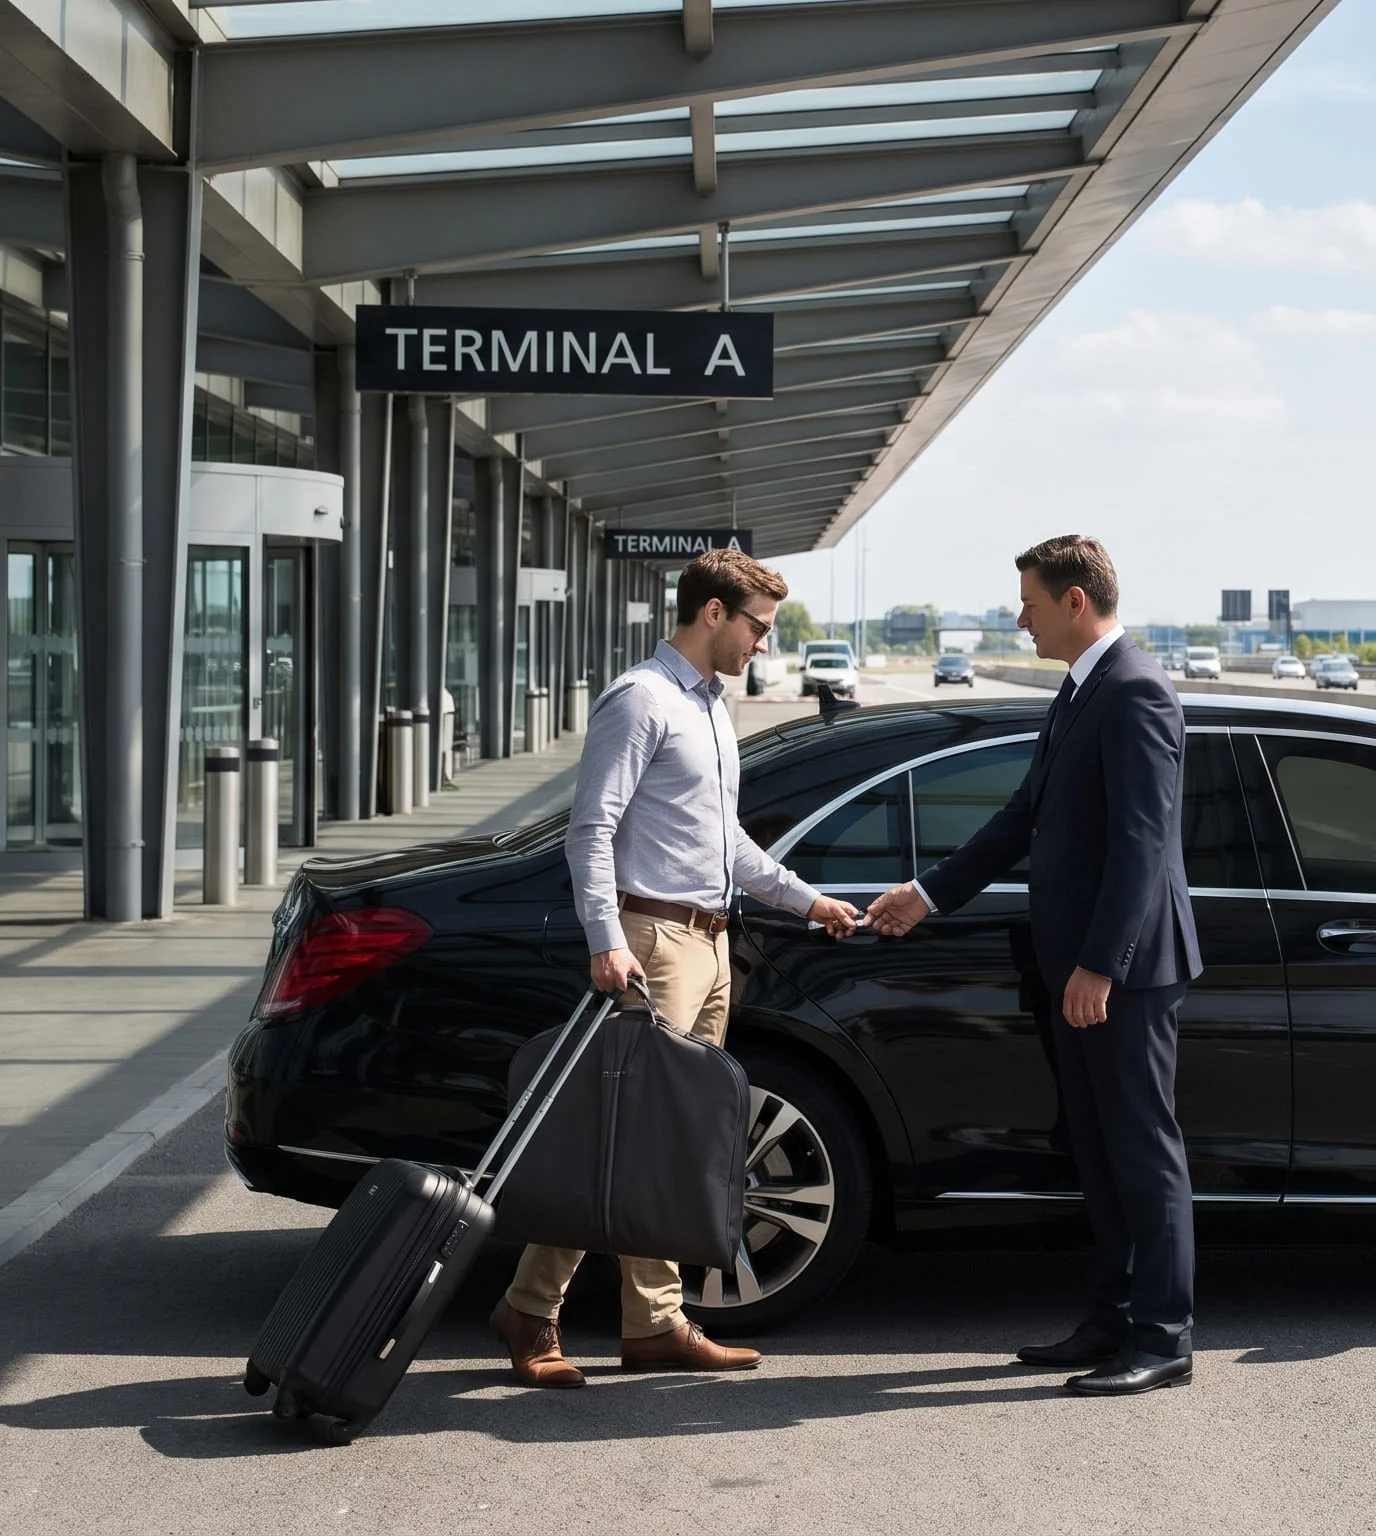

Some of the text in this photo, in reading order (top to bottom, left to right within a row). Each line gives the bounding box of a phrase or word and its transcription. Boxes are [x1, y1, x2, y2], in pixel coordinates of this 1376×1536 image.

[385, 327, 746, 377] TERMINAL A
[614, 535, 743, 553] TERMINAL A
